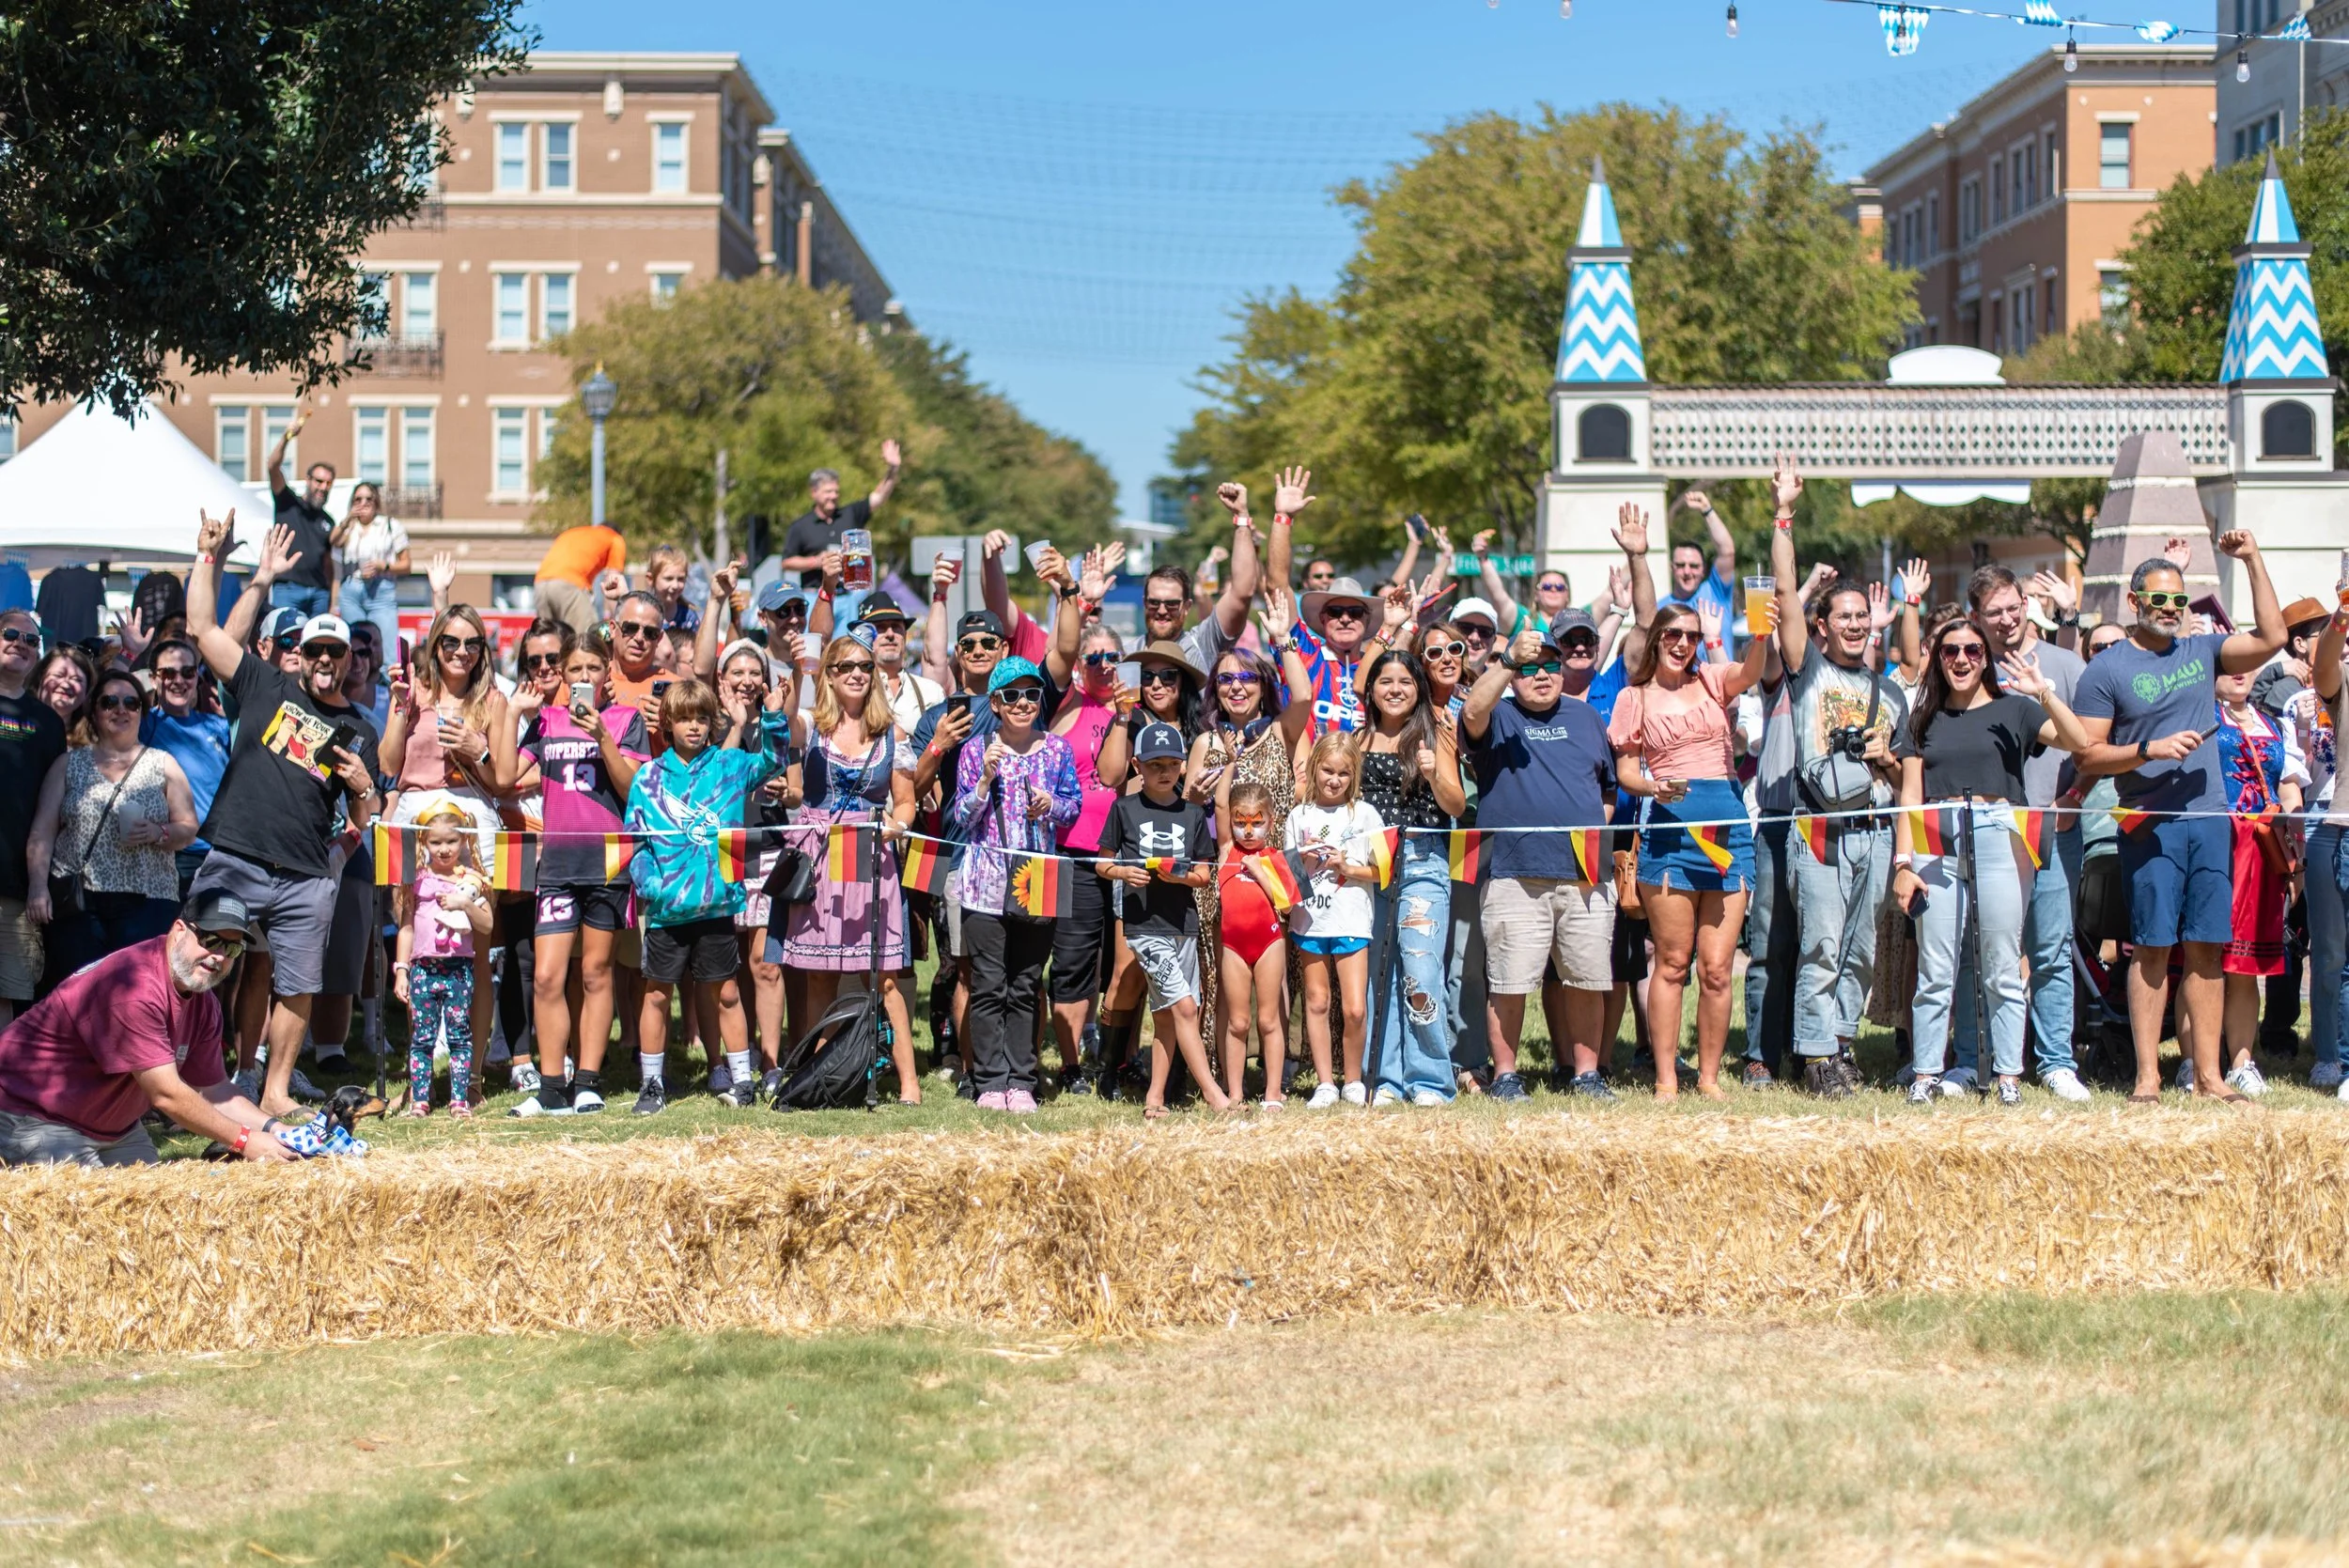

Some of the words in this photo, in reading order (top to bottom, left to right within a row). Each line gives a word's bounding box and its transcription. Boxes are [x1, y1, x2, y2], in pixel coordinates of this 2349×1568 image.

[2162, 659, 2204, 688] MAUI
[285, 705, 302, 718] SHOW
[302, 715, 312, 725] ME
[313, 720, 331, 735] YOUR
[1314, 700, 1365, 727] OPE
[1524, 728, 1551, 737] SIGMA
[563, 763, 596, 791] 13
[539, 895, 575, 924] 13
